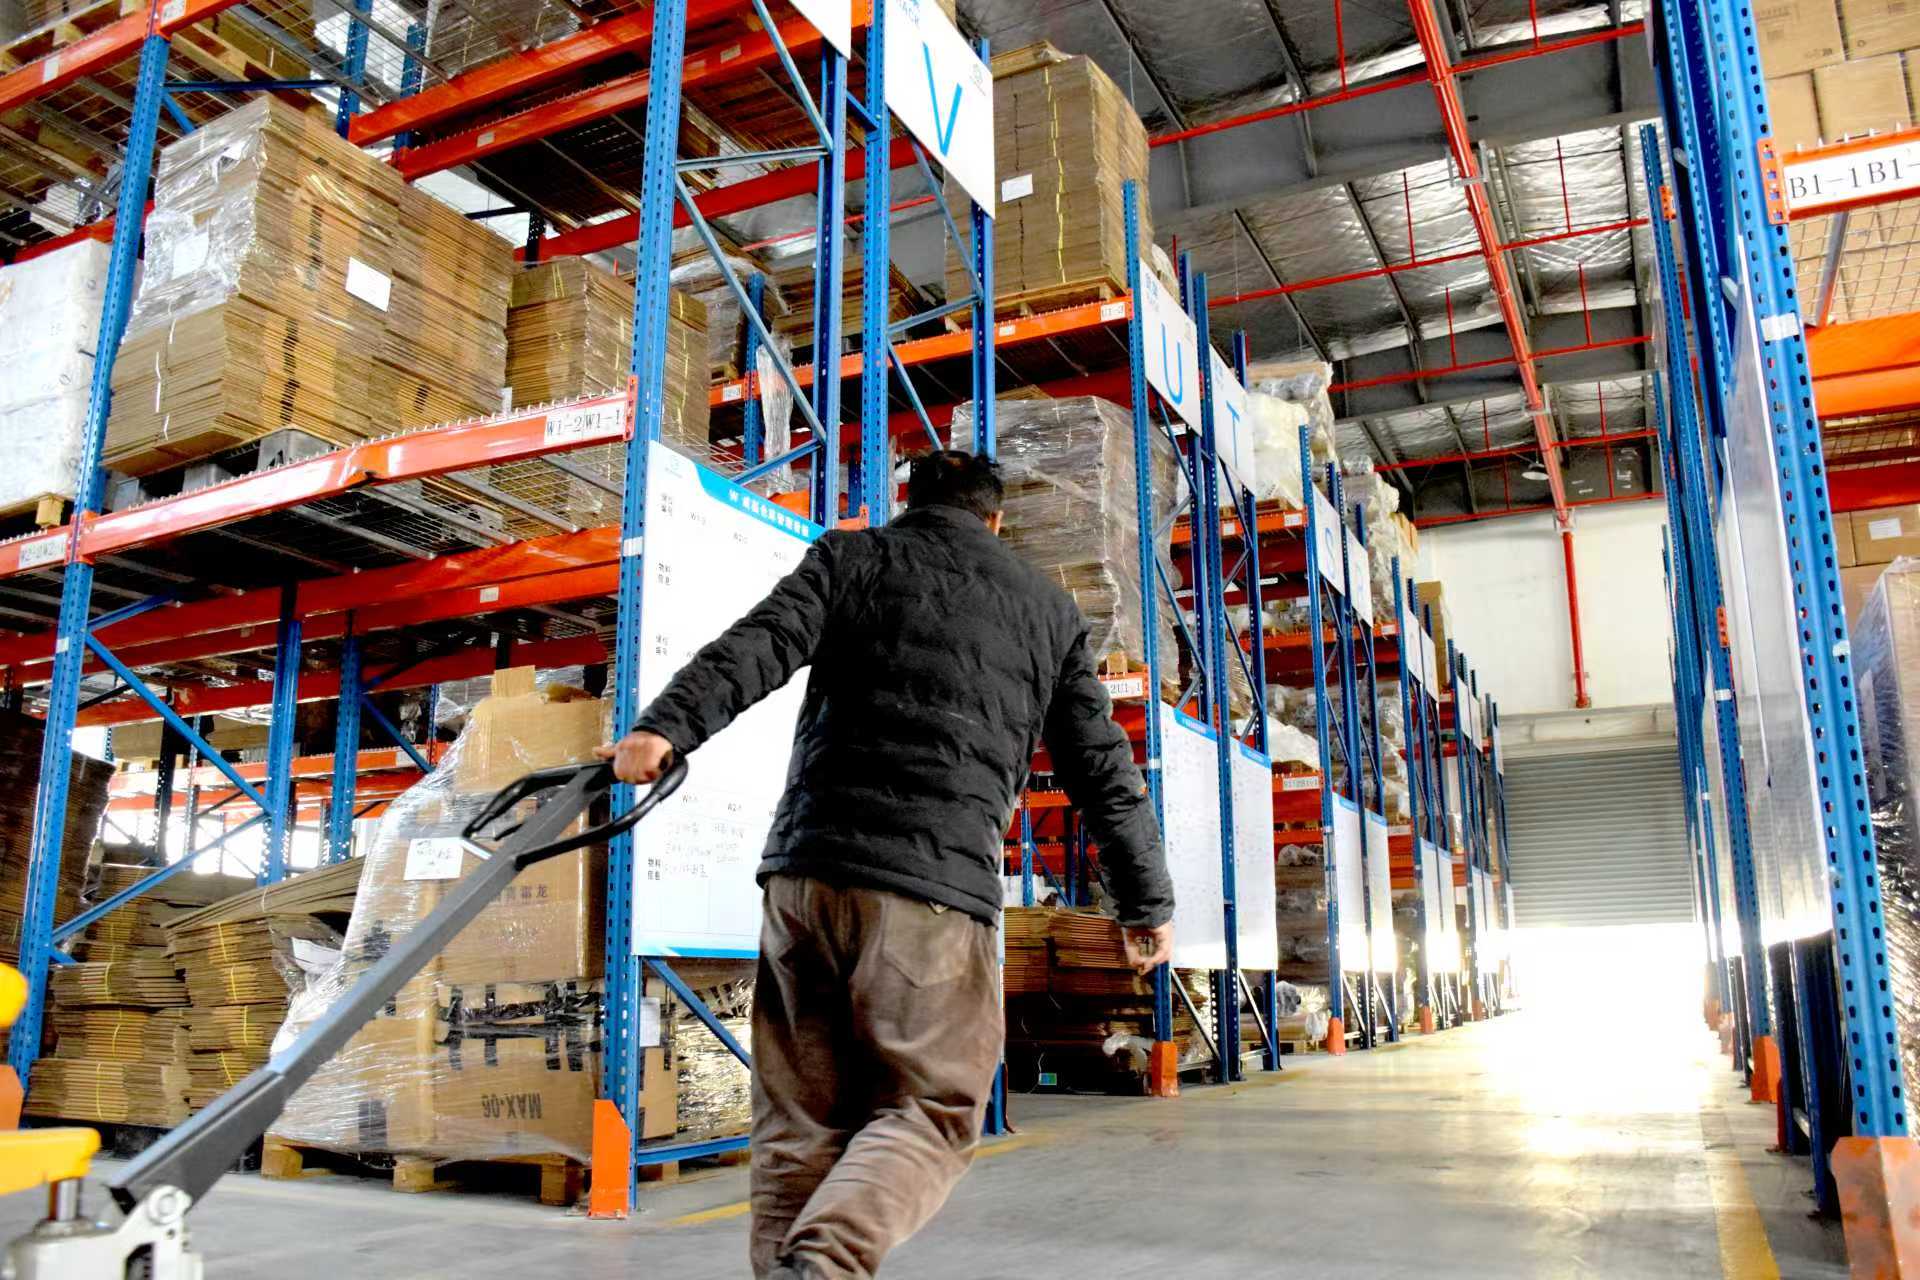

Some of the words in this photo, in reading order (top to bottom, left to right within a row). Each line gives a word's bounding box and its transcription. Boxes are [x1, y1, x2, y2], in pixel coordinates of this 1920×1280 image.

[922, 41, 963, 157] V
[1161, 323, 1182, 405] U
[1226, 400, 1240, 469] T
